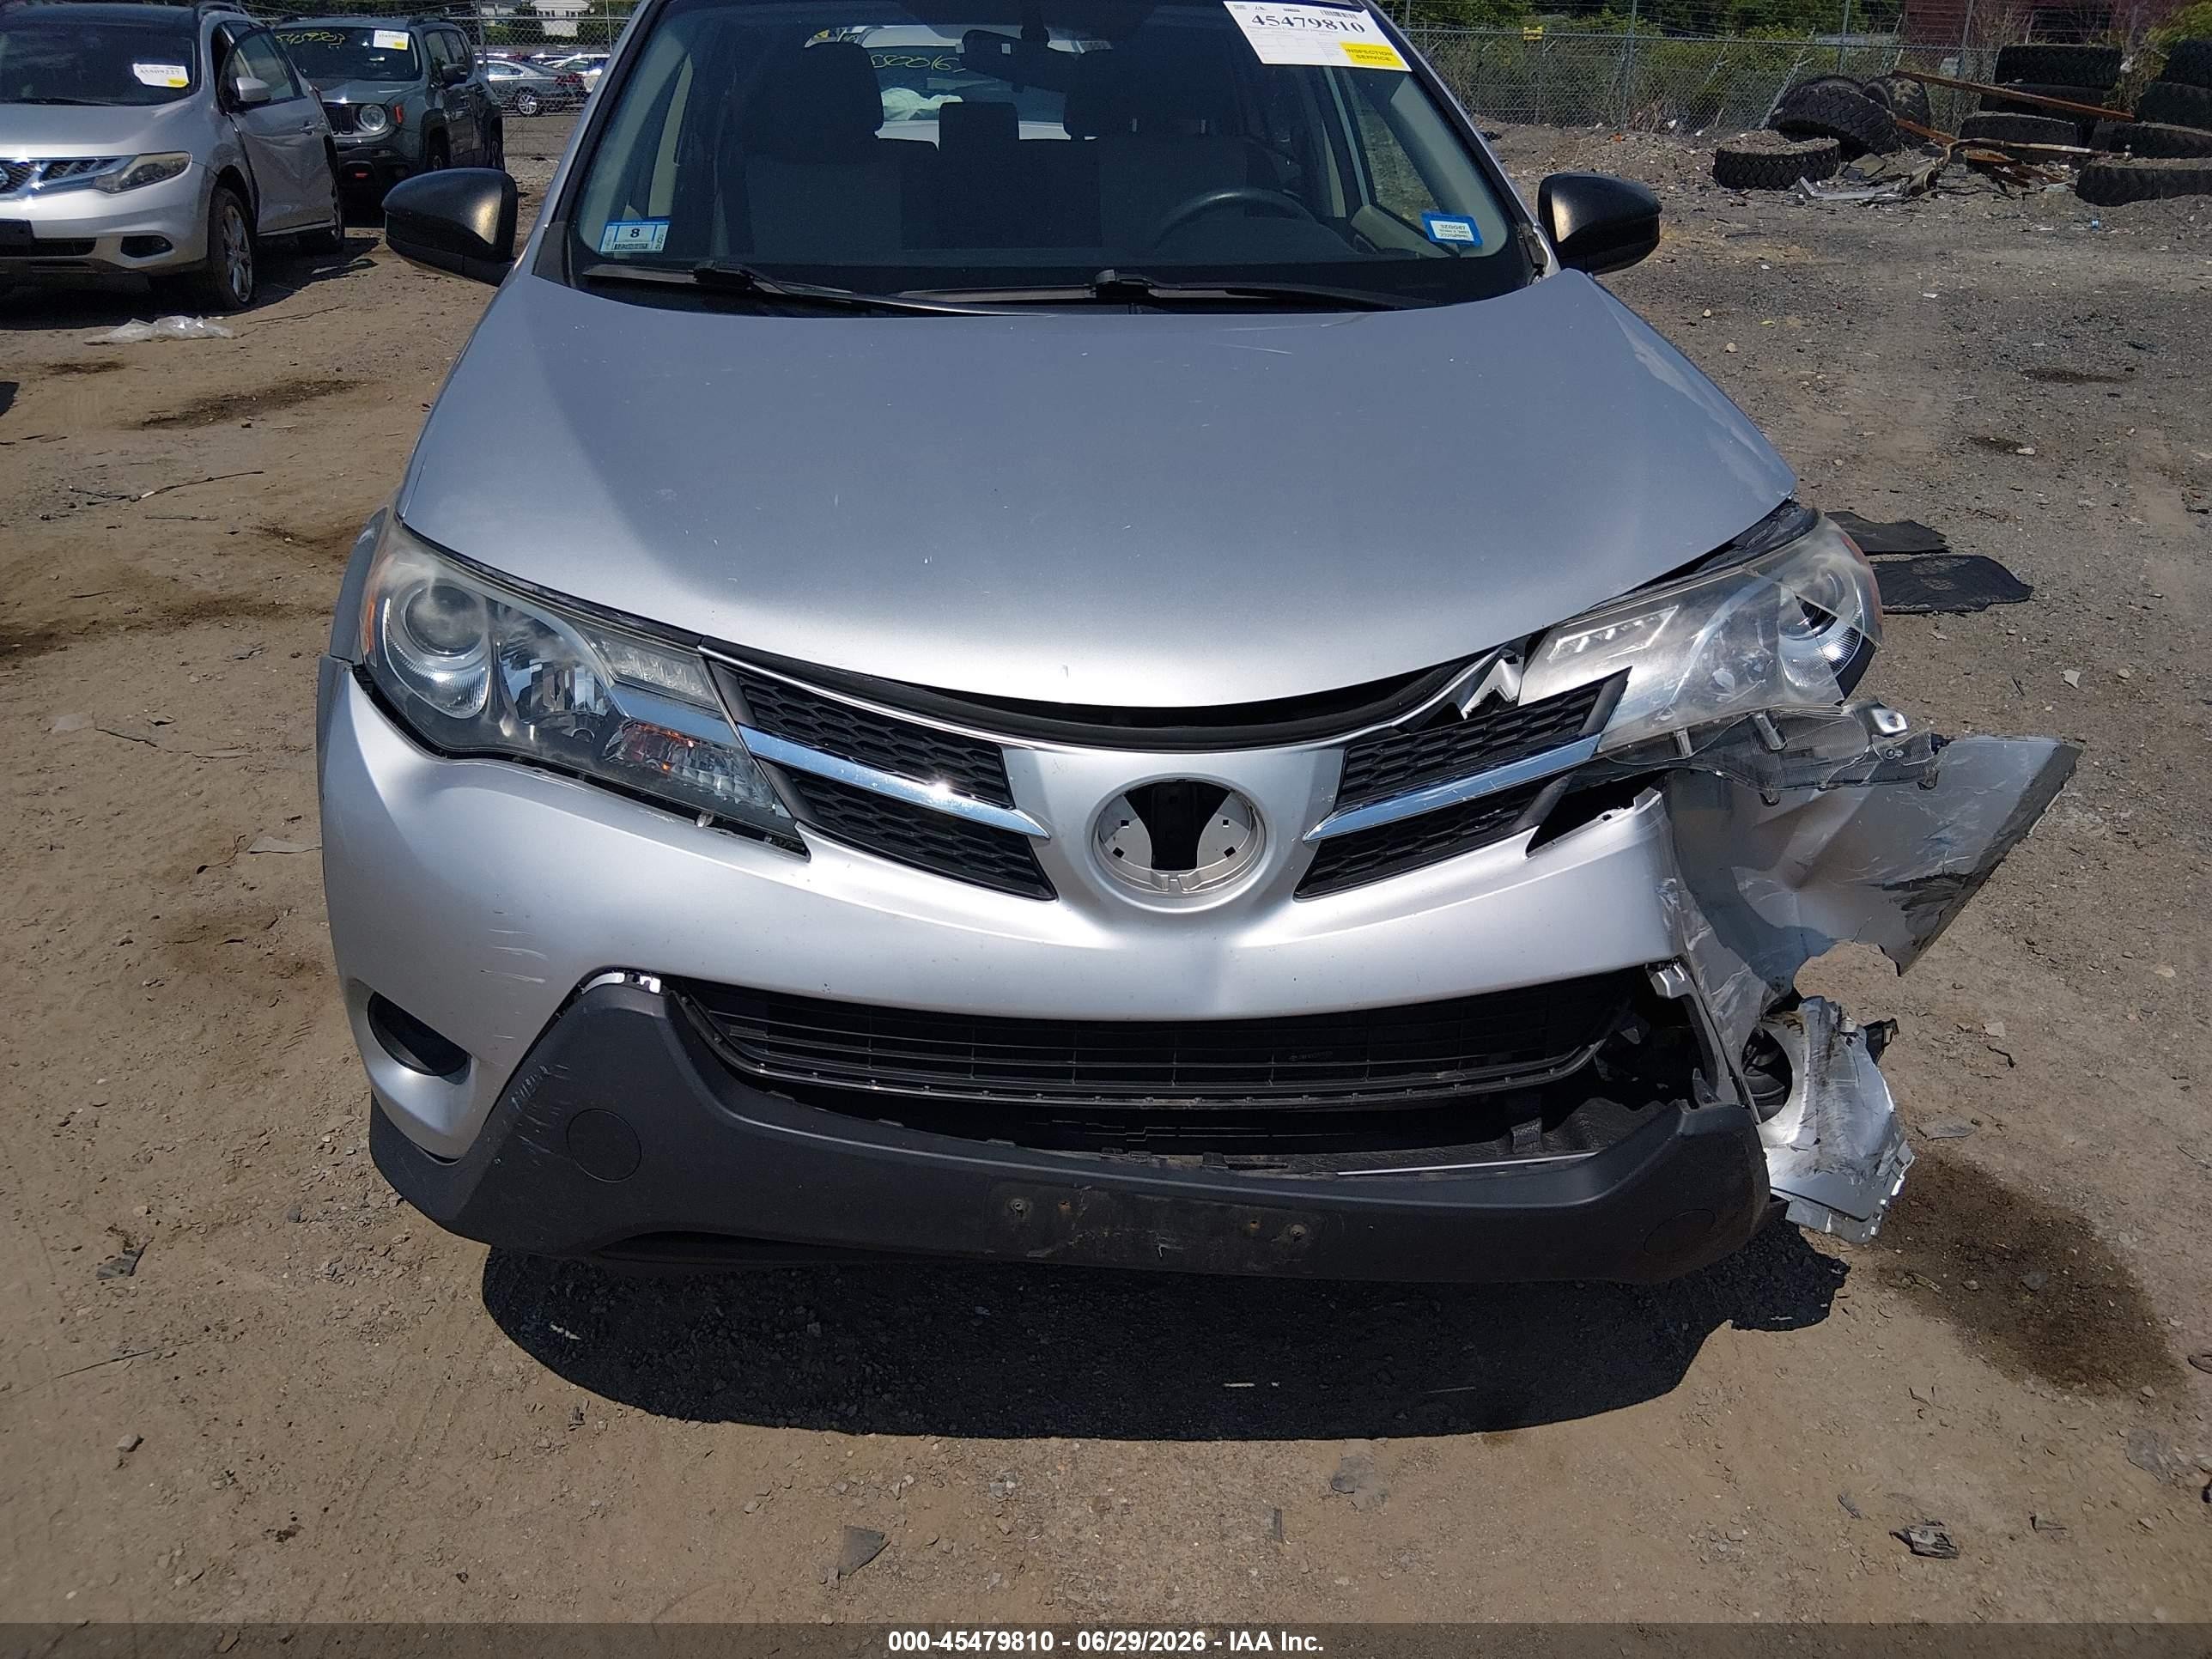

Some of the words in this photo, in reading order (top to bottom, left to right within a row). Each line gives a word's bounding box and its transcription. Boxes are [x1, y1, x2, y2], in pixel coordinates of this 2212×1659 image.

[1251, 14, 1365, 33] 45479810
[1345, 47, 1394, 57] INSPECTION
[630, 228, 641, 238] 8
